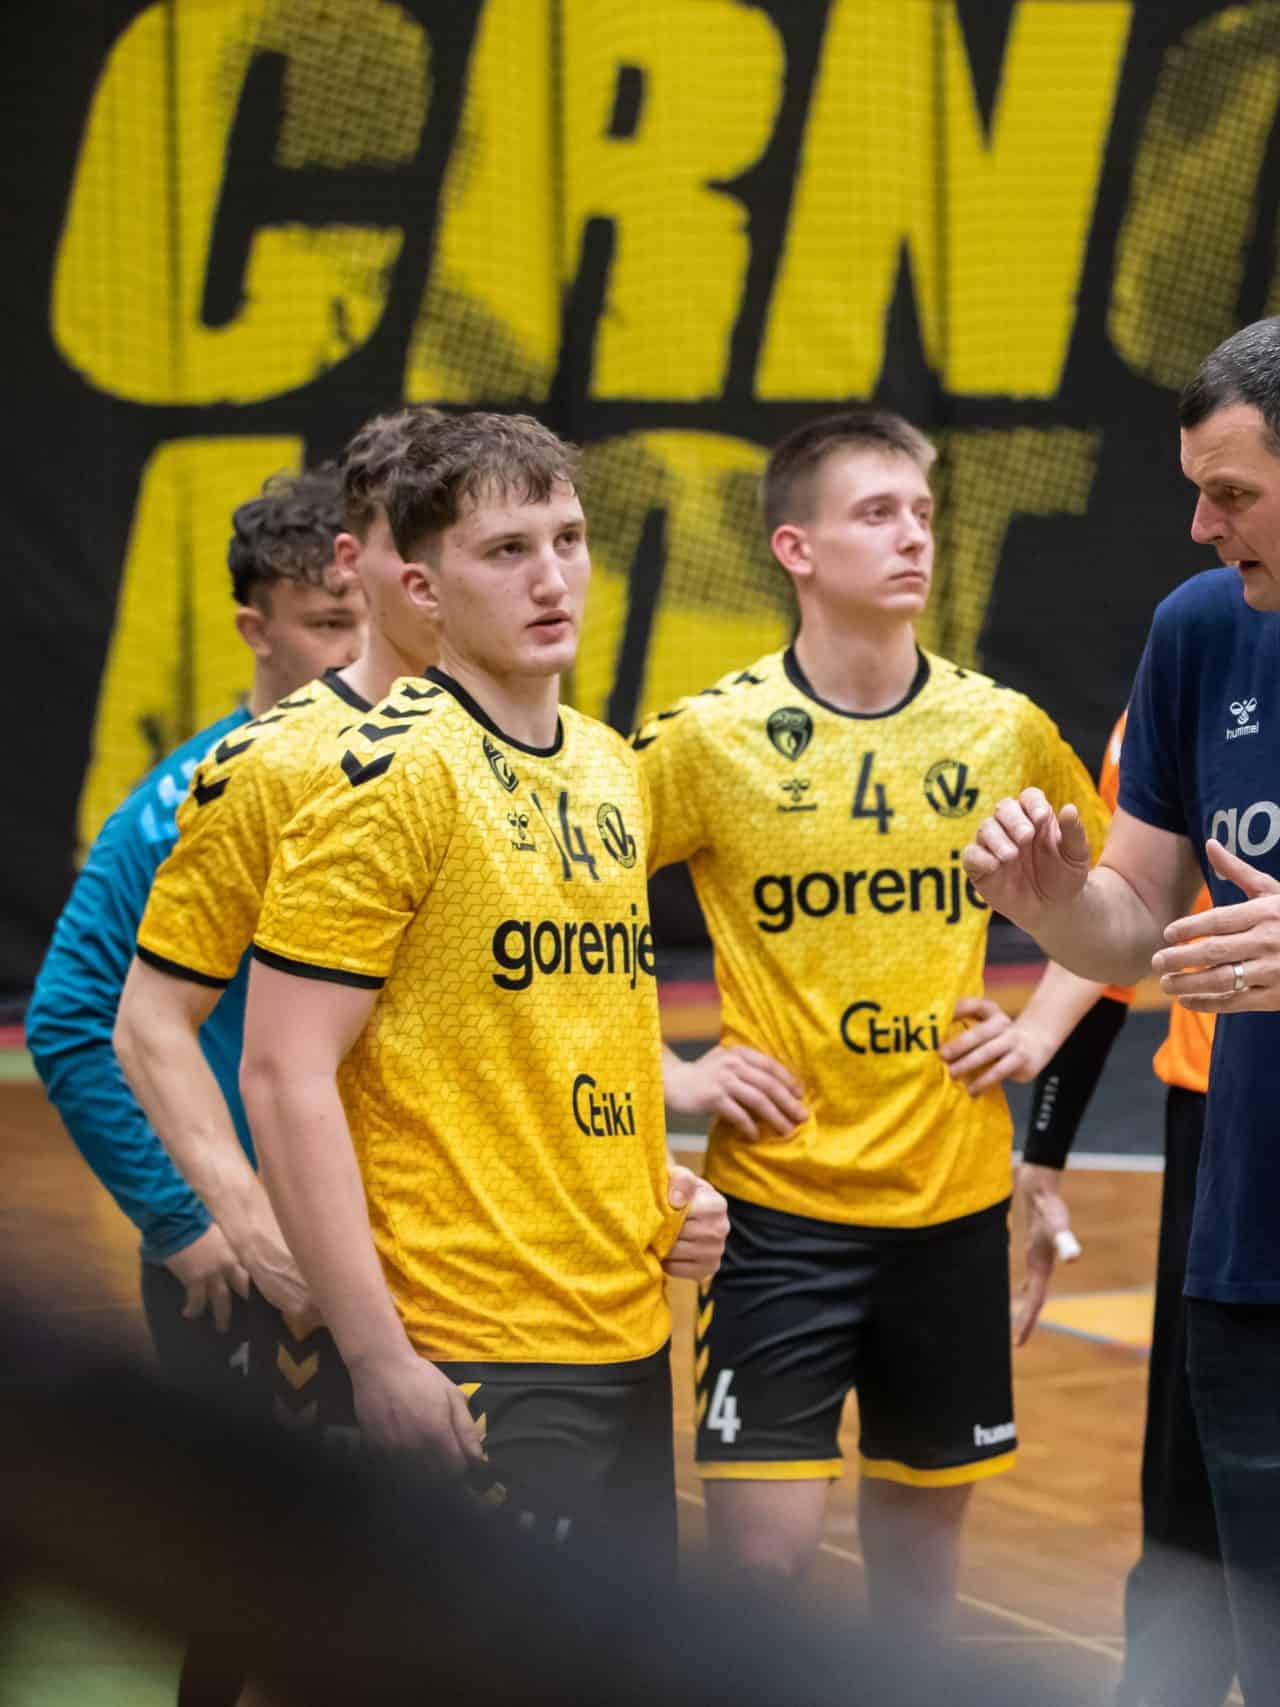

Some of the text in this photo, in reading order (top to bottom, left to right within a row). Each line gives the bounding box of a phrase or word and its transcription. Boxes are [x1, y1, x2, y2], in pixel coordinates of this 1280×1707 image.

[1226, 719, 1260, 741] hummel
[851, 751, 895, 835] 4
[530, 790, 600, 881] 14
[492, 903, 657, 991] gorenje
[706, 1369, 742, 1443] 4
